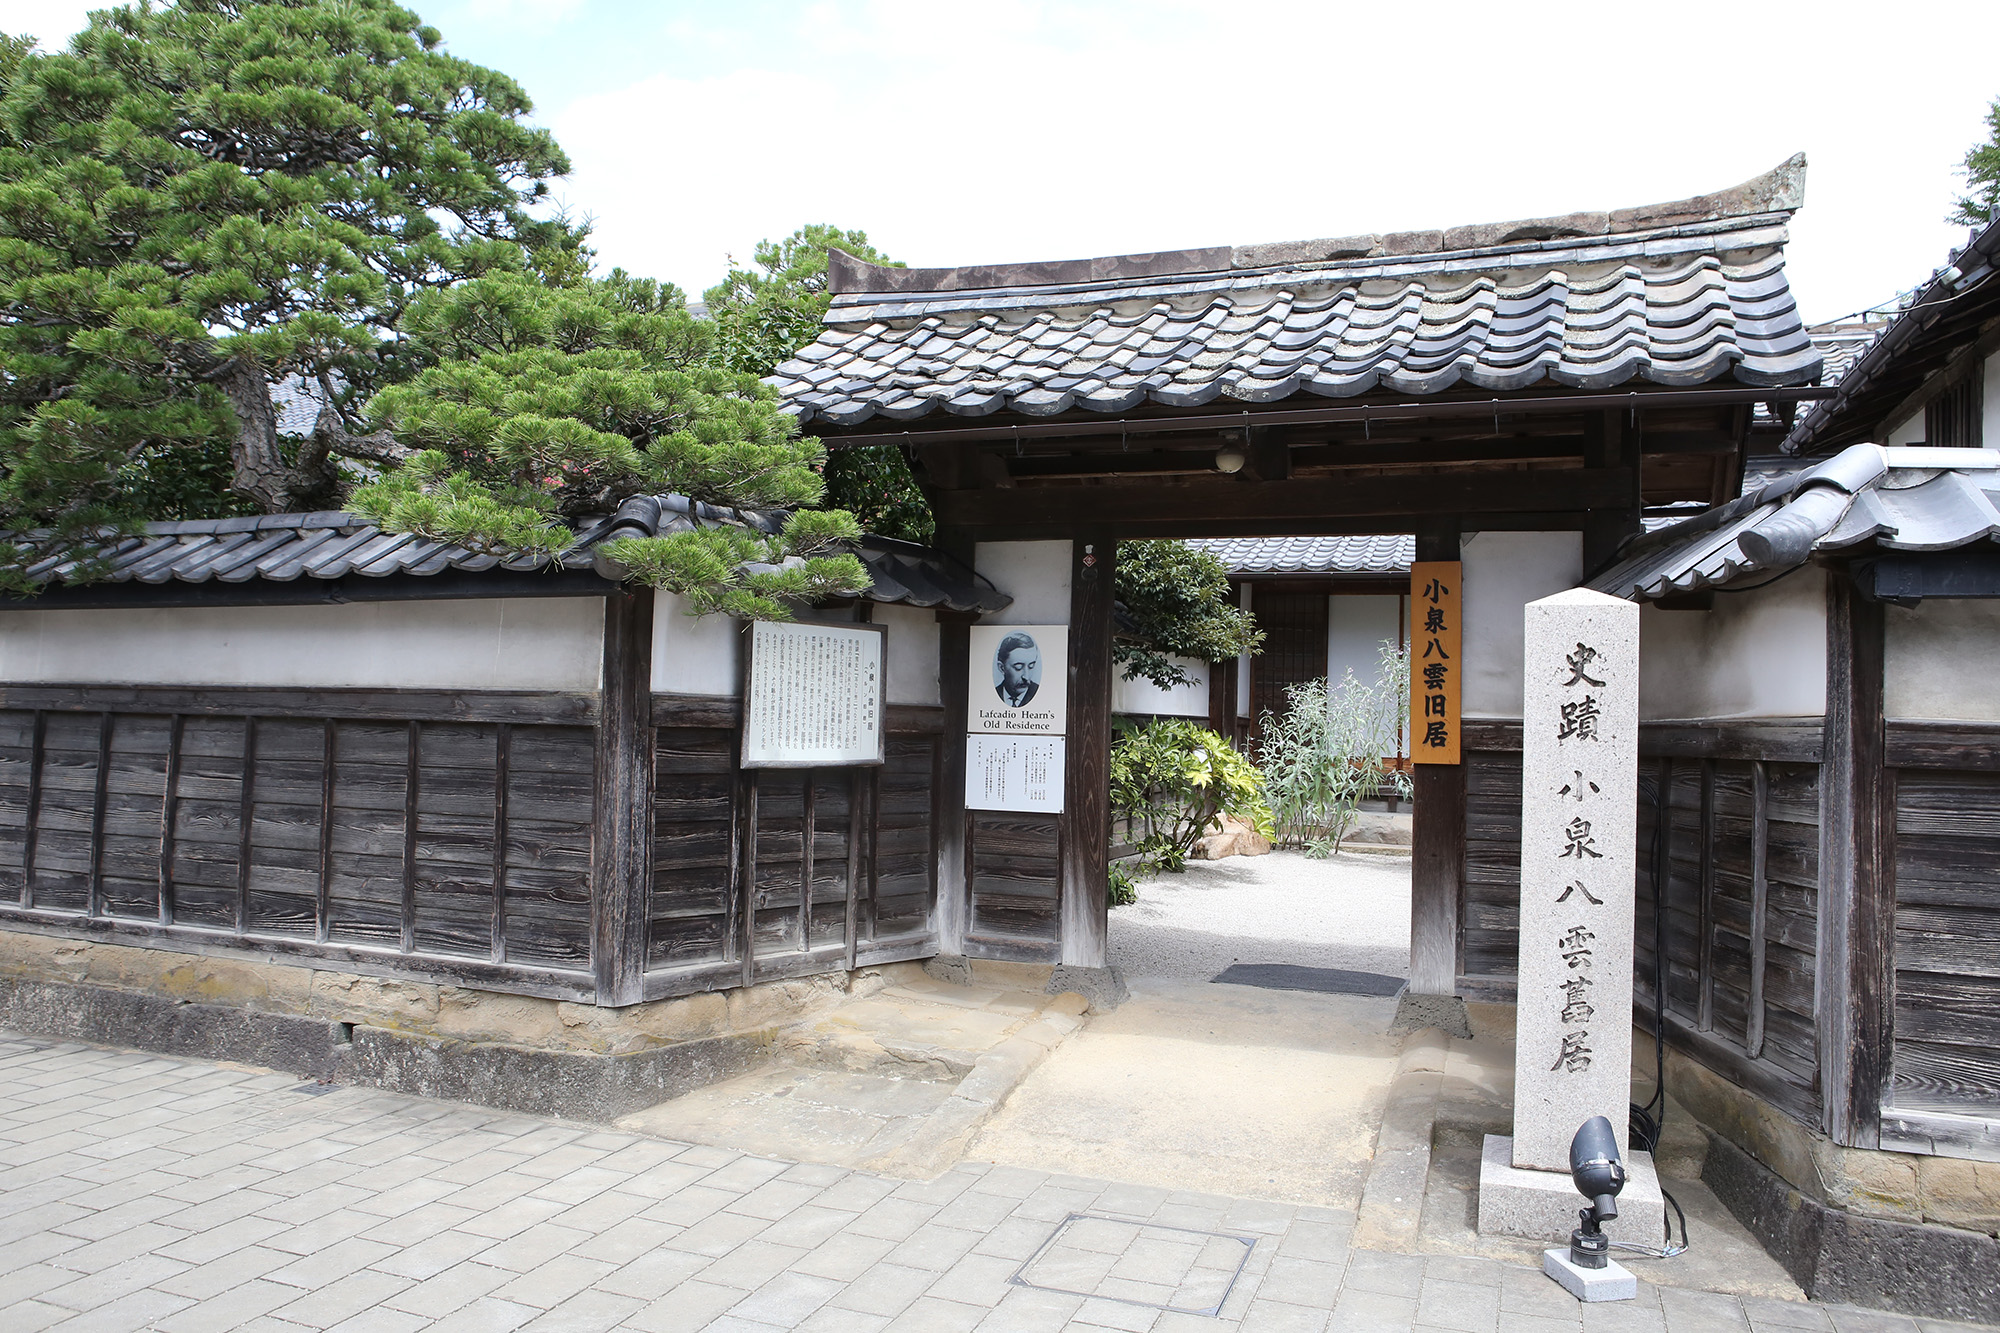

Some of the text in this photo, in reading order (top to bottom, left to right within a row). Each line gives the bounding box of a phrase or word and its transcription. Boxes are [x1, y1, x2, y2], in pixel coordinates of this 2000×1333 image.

[1422, 578, 1450, 748] 小泉八雲旧居
[867, 661, 876, 731] 小泉八雲旧居
[979, 710, 1055, 719] Lafcadio Hearn's
[983, 720, 1050, 730] Old Residence
